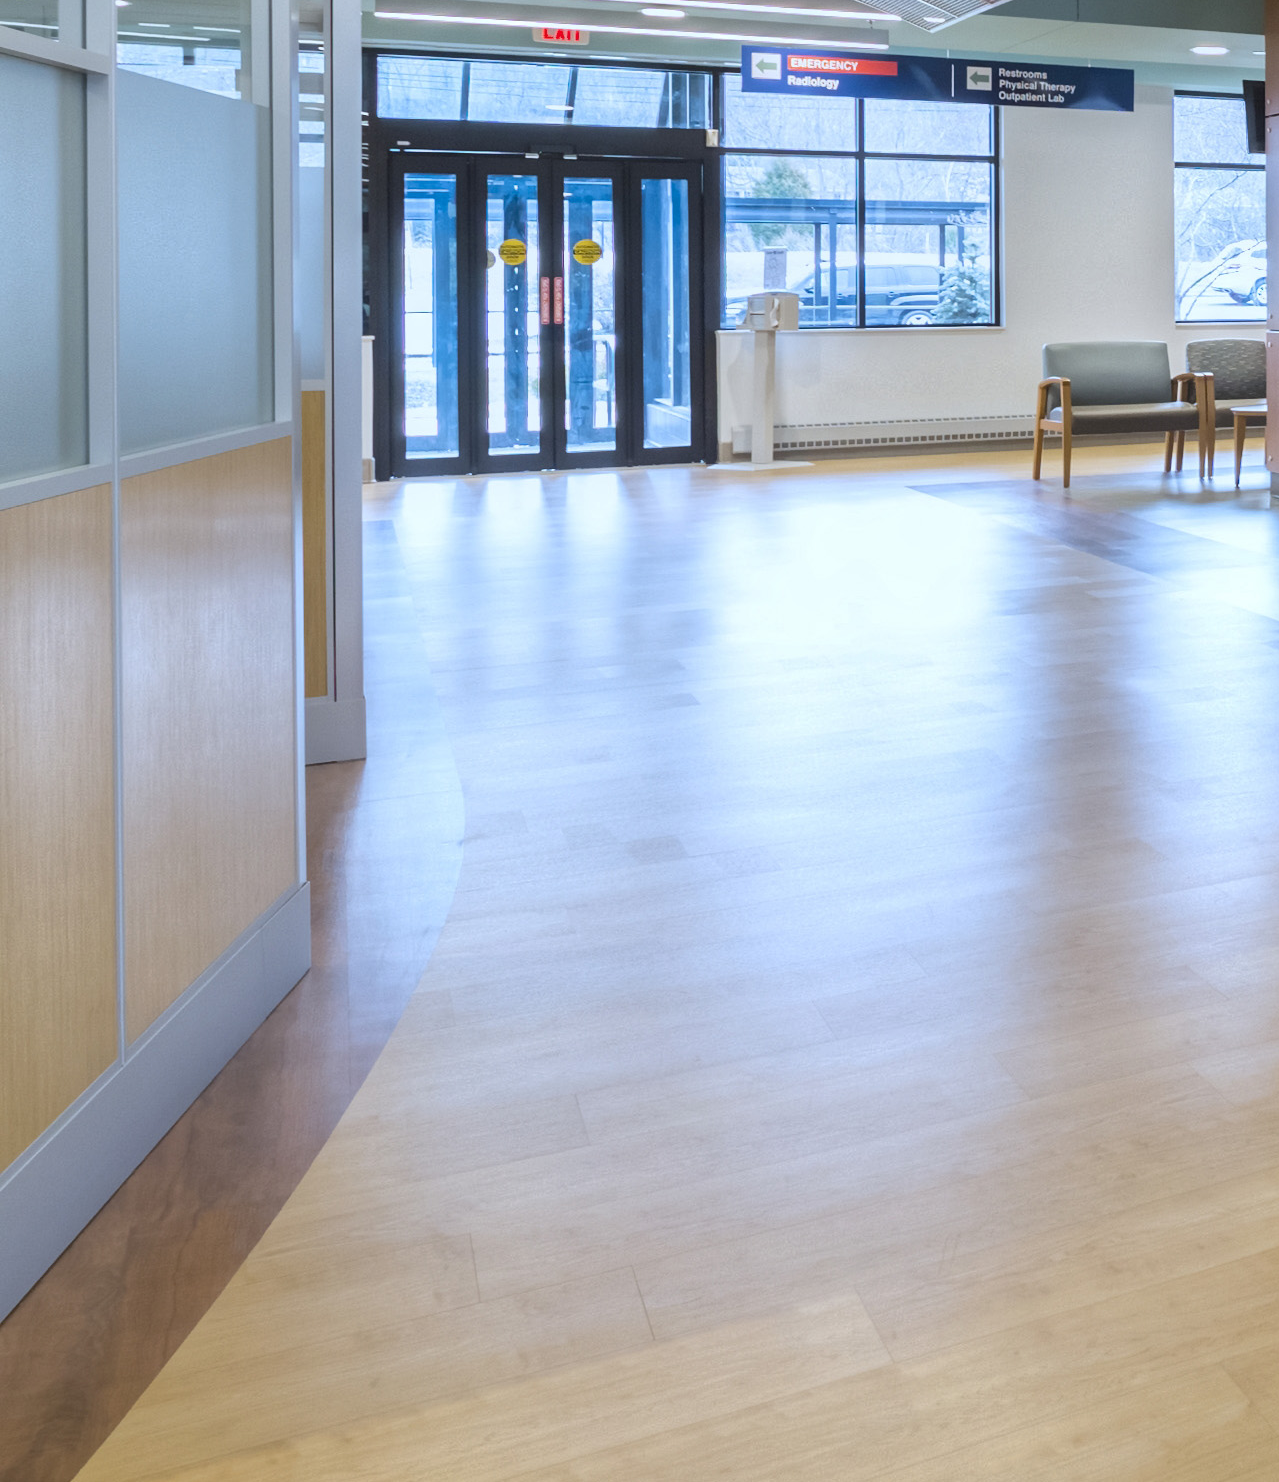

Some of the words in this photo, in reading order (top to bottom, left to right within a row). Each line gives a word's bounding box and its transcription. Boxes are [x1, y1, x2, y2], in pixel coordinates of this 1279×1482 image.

[790, 57, 858, 71] EMERGENCY
[998, 67, 1048, 80] Restrooms
[787, 75, 840, 90] Radiology
[999, 79, 1038, 91] Physical
[1040, 81, 1076, 94] Therapy
[998, 91, 1046, 103] Outpatient
[1048, 93, 1065, 103] Lab
